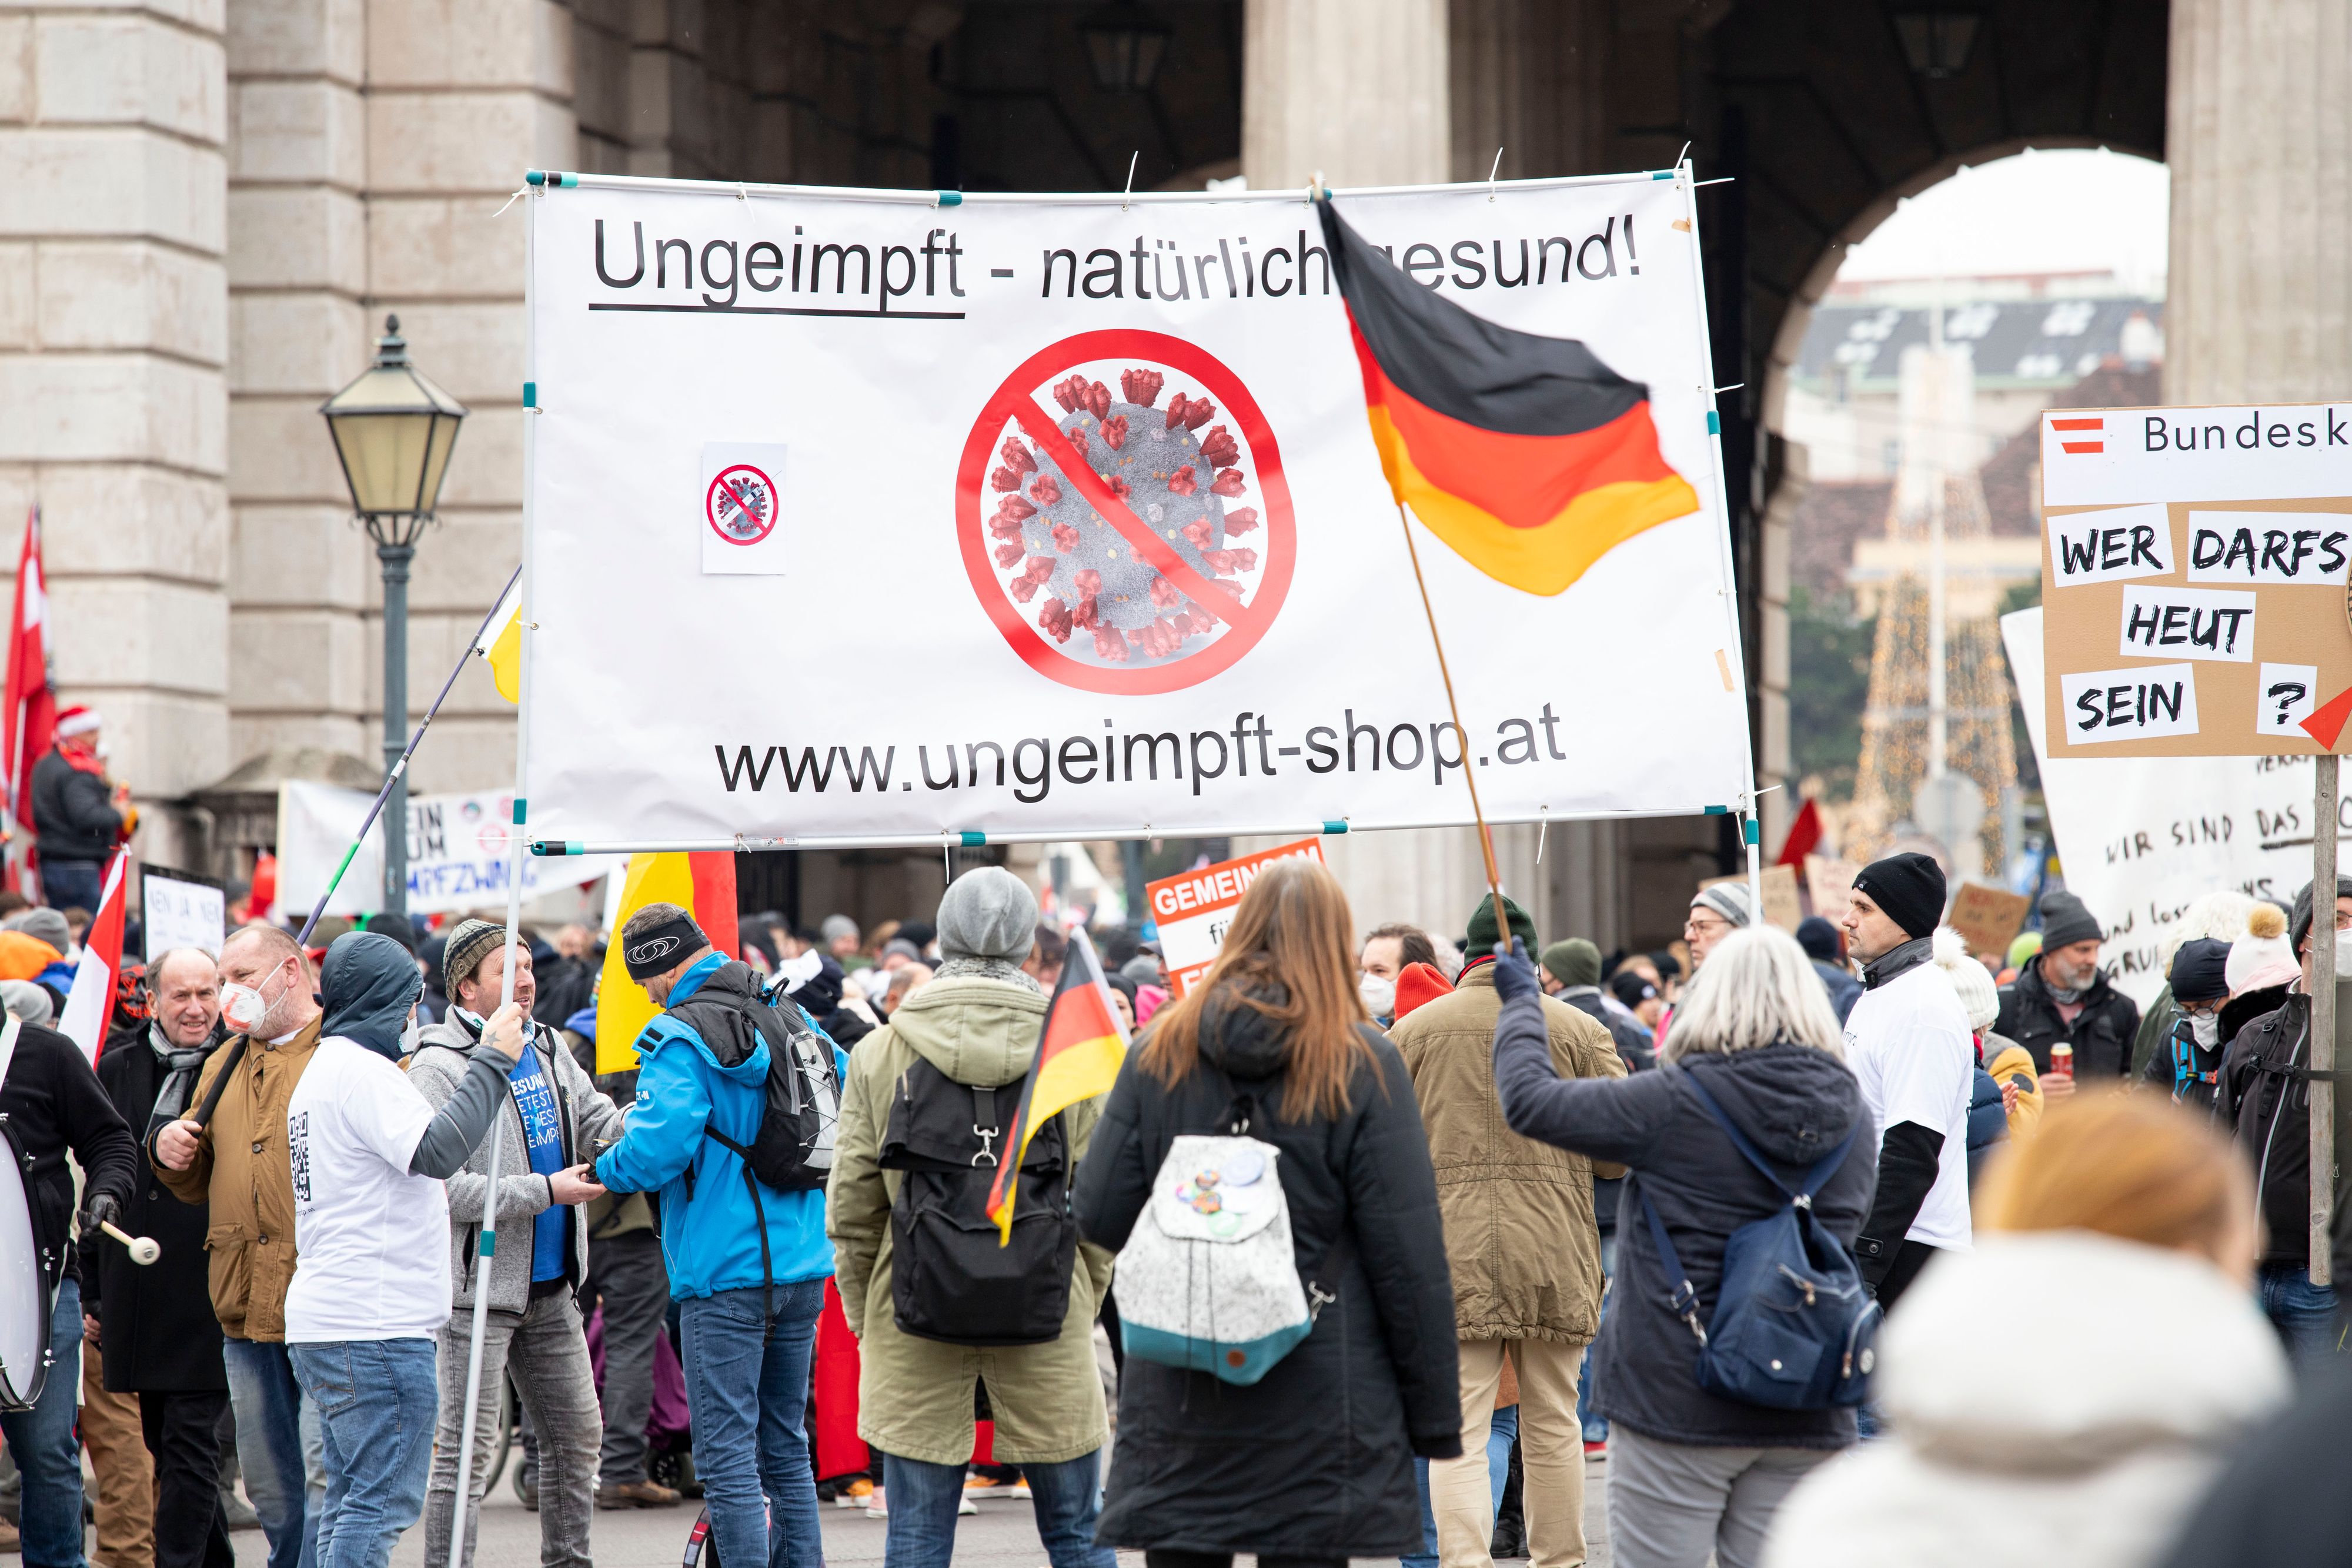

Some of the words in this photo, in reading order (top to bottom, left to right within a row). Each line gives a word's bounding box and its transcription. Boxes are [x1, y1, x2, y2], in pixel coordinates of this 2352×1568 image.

[594, 219, 965, 312] Ungeimpft
[991, 269, 1014, 278] -
[1042, 229, 1330, 302] natürlich
[2145, 407, 2349, 452] Bundesk
[2060, 524, 2163, 575] WER
[2193, 527, 2349, 577] DARFS
[2127, 603, 2253, 654] HEUT
[2077, 681, 2183, 731] SEIN
[2267, 682, 2306, 725] ?
[715, 702, 1567, 804] www.ungeimpft-shop.at
[2106, 831, 2153, 865] WIR
[2171, 813, 2233, 847] SIND
[2255, 803, 2300, 838] DAS
[1209, 920, 1230, 945] fü
[510, 1071, 547, 1096] ESUN
[516, 1089, 553, 1114] ETEST
[527, 1126, 559, 1148] EIMP
